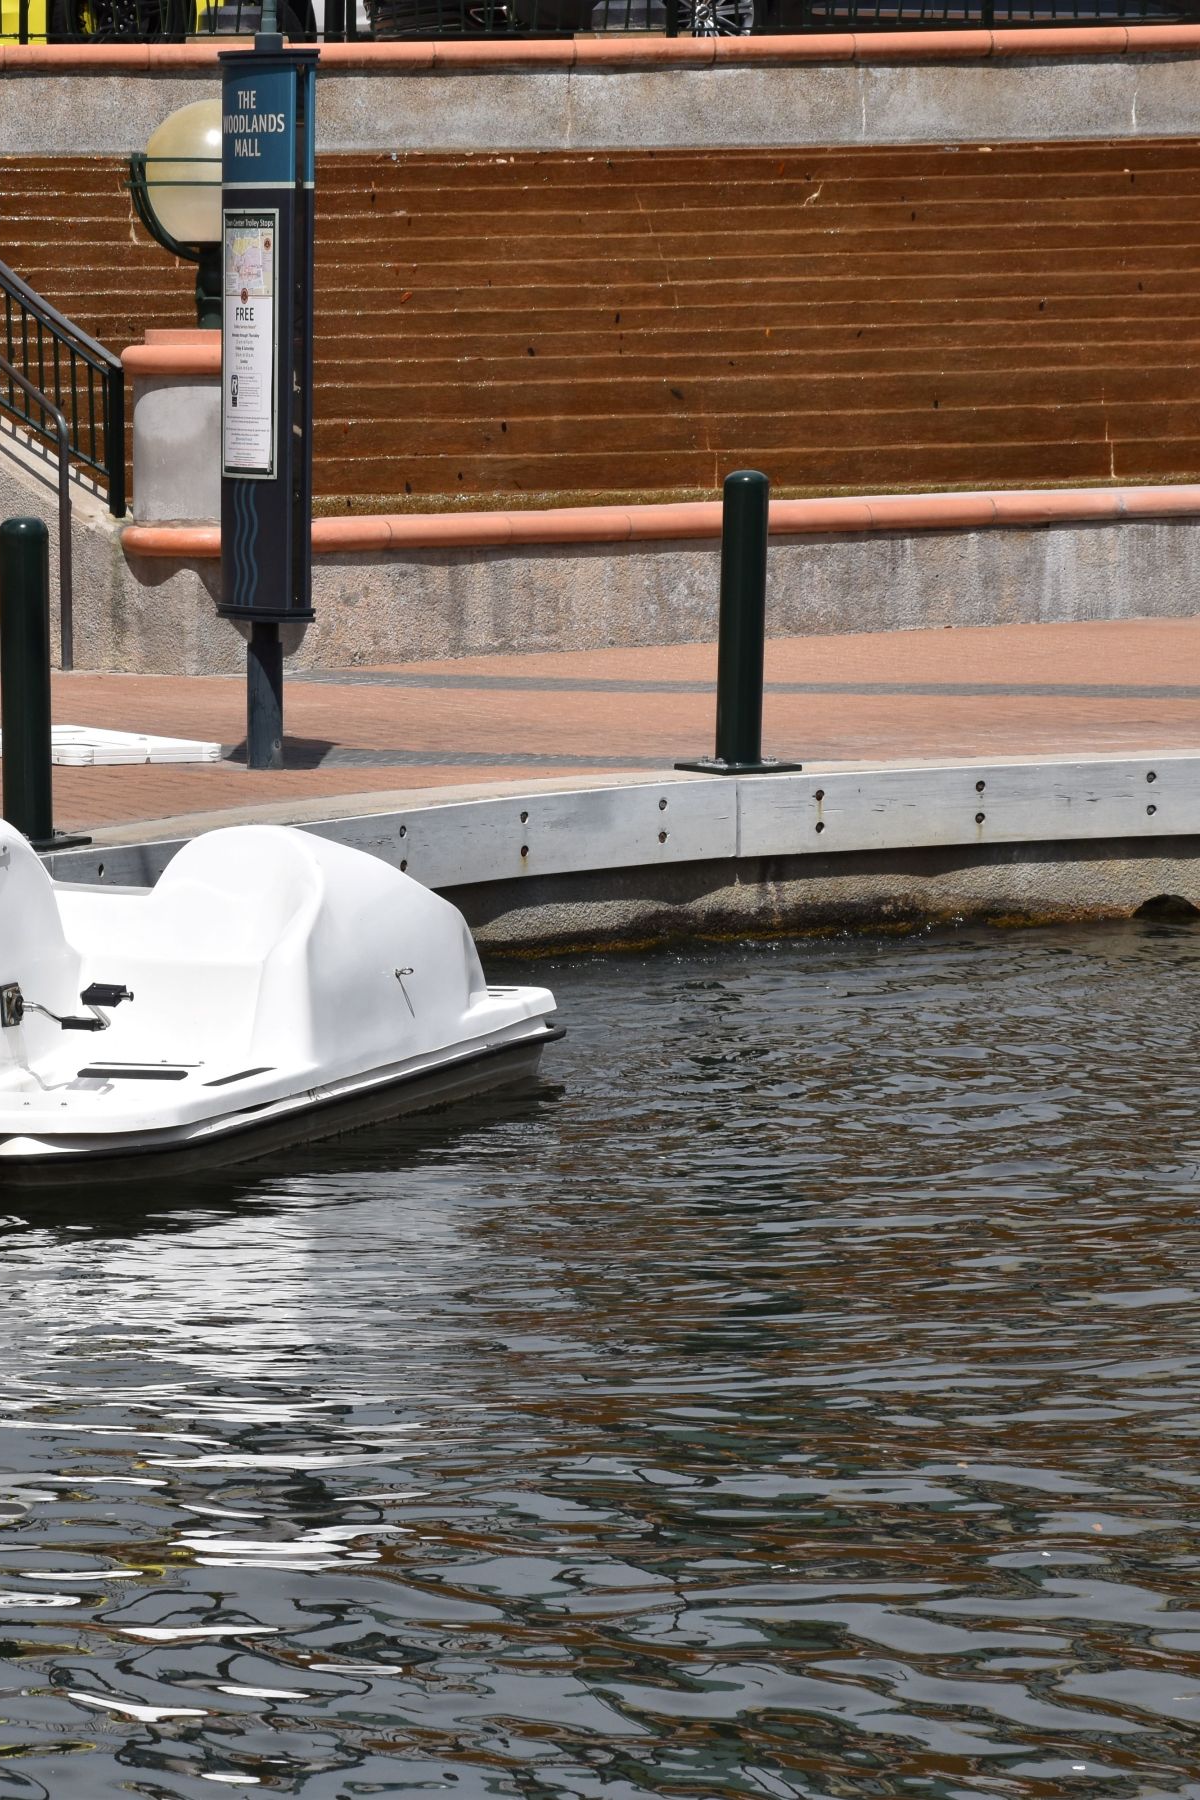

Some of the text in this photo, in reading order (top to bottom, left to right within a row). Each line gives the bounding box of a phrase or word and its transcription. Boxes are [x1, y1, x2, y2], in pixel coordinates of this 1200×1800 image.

[238, 90, 256, 109] THE
[223, 113, 285, 134] WOODLANDS
[234, 138, 261, 156] MALL
[245, 218, 259, 228] Trolley
[259, 218, 274, 228] Stops
[235, 307, 254, 321] FREE
